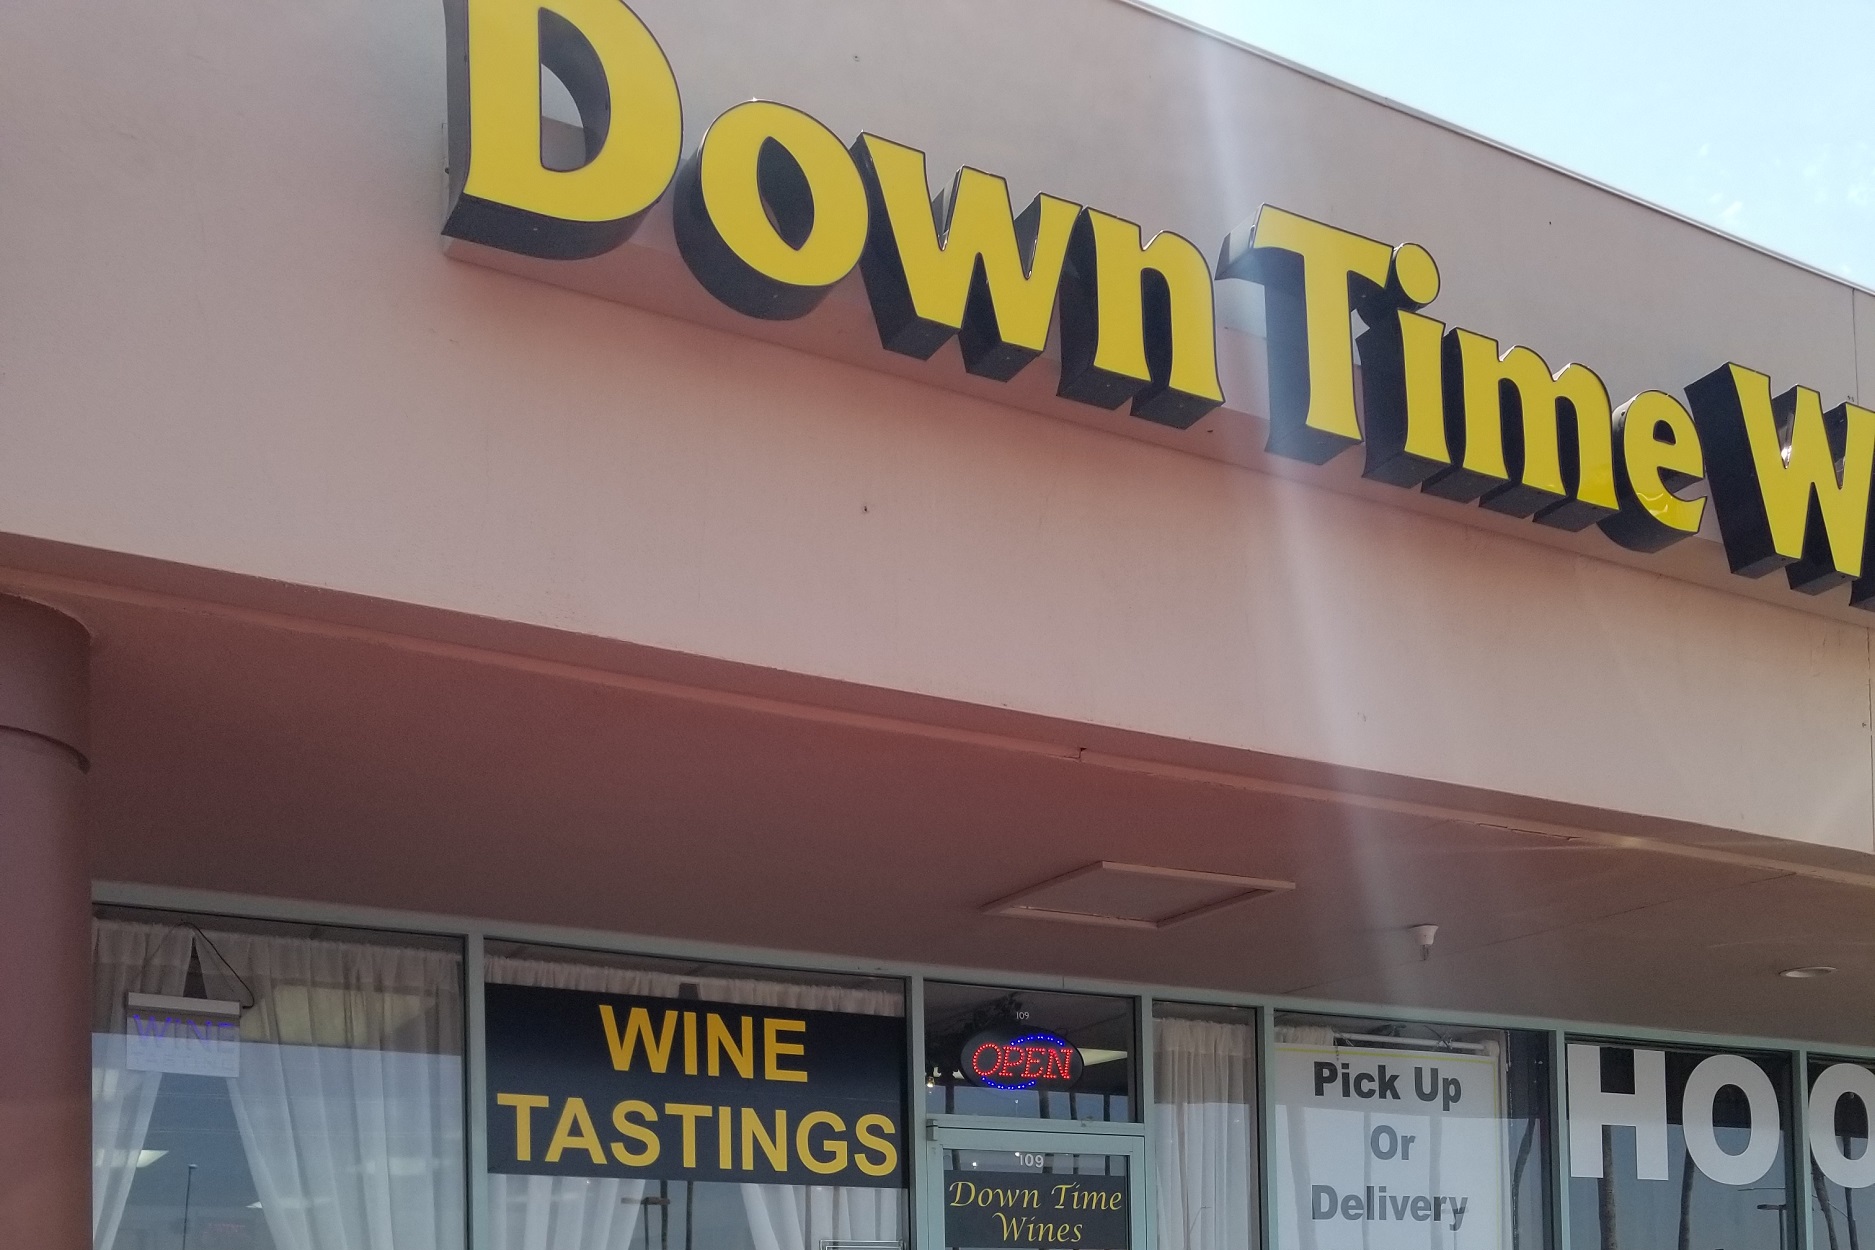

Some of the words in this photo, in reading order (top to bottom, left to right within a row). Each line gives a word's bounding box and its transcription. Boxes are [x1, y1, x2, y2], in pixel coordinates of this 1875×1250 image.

[450, 0, 1224, 404] Down
[1242, 203, 1708, 535] Time
[1016, 1011, 1030, 1020] 109
[599, 1004, 808, 1083] WINE
[972, 1043, 1073, 1080] OPEN
[1313, 1061, 1401, 1100] Pick
[1413, 1066, 1462, 1112] Up
[497, 1092, 898, 1177] TASTINGS
[1370, 1124, 1416, 1161] Or
[1019, 1153, 1044, 1168] 109
[949, 1181, 1041, 1209] Down
[1051, 1181, 1123, 1211] Time
[1311, 1184, 1469, 1231] Delivery
[992, 1212, 1083, 1243] Wines
